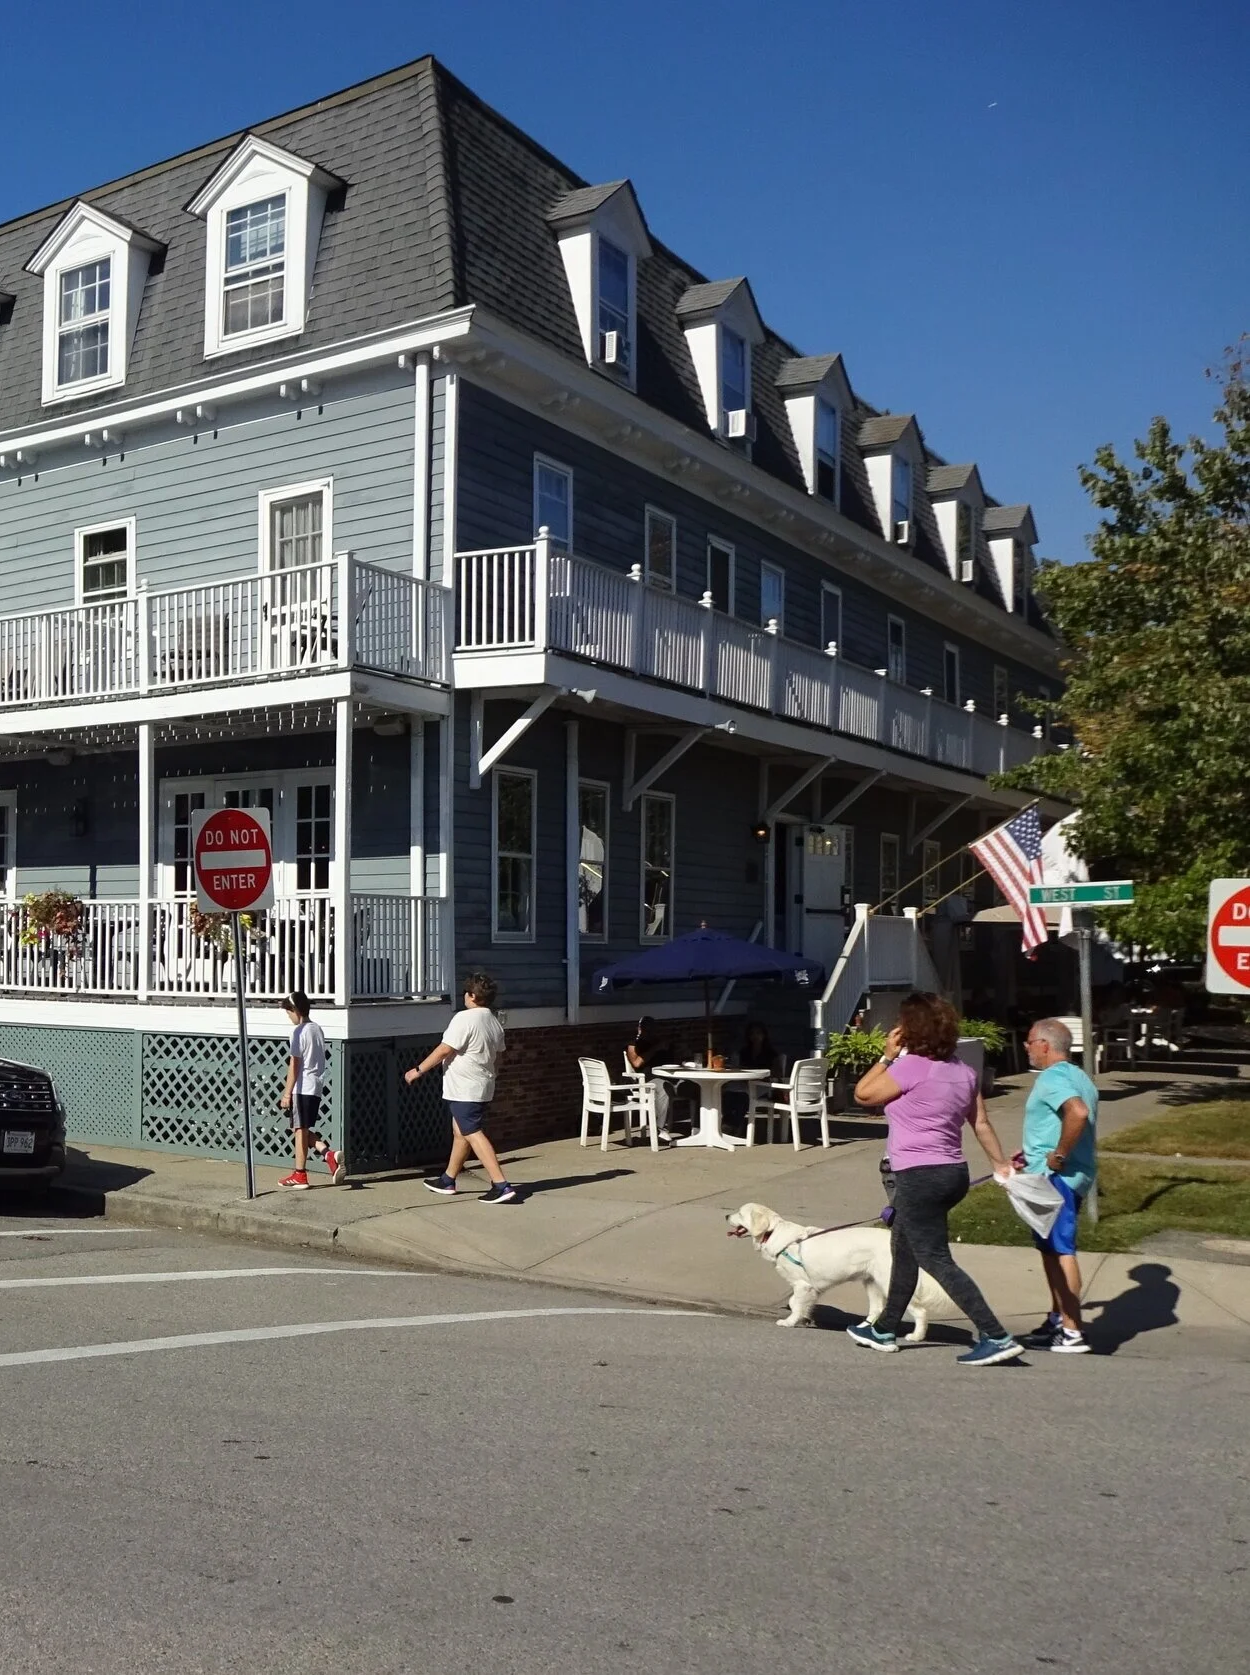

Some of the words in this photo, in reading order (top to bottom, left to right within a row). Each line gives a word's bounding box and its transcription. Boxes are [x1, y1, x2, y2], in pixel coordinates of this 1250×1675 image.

[205, 830, 224, 845] DO
[230, 828, 258, 844] NOT
[213, 873, 256, 891] ENTER
[1041, 888, 1076, 901] WEST
[1103, 886, 1120, 900] ST
[1232, 902, 1250, 920] D
